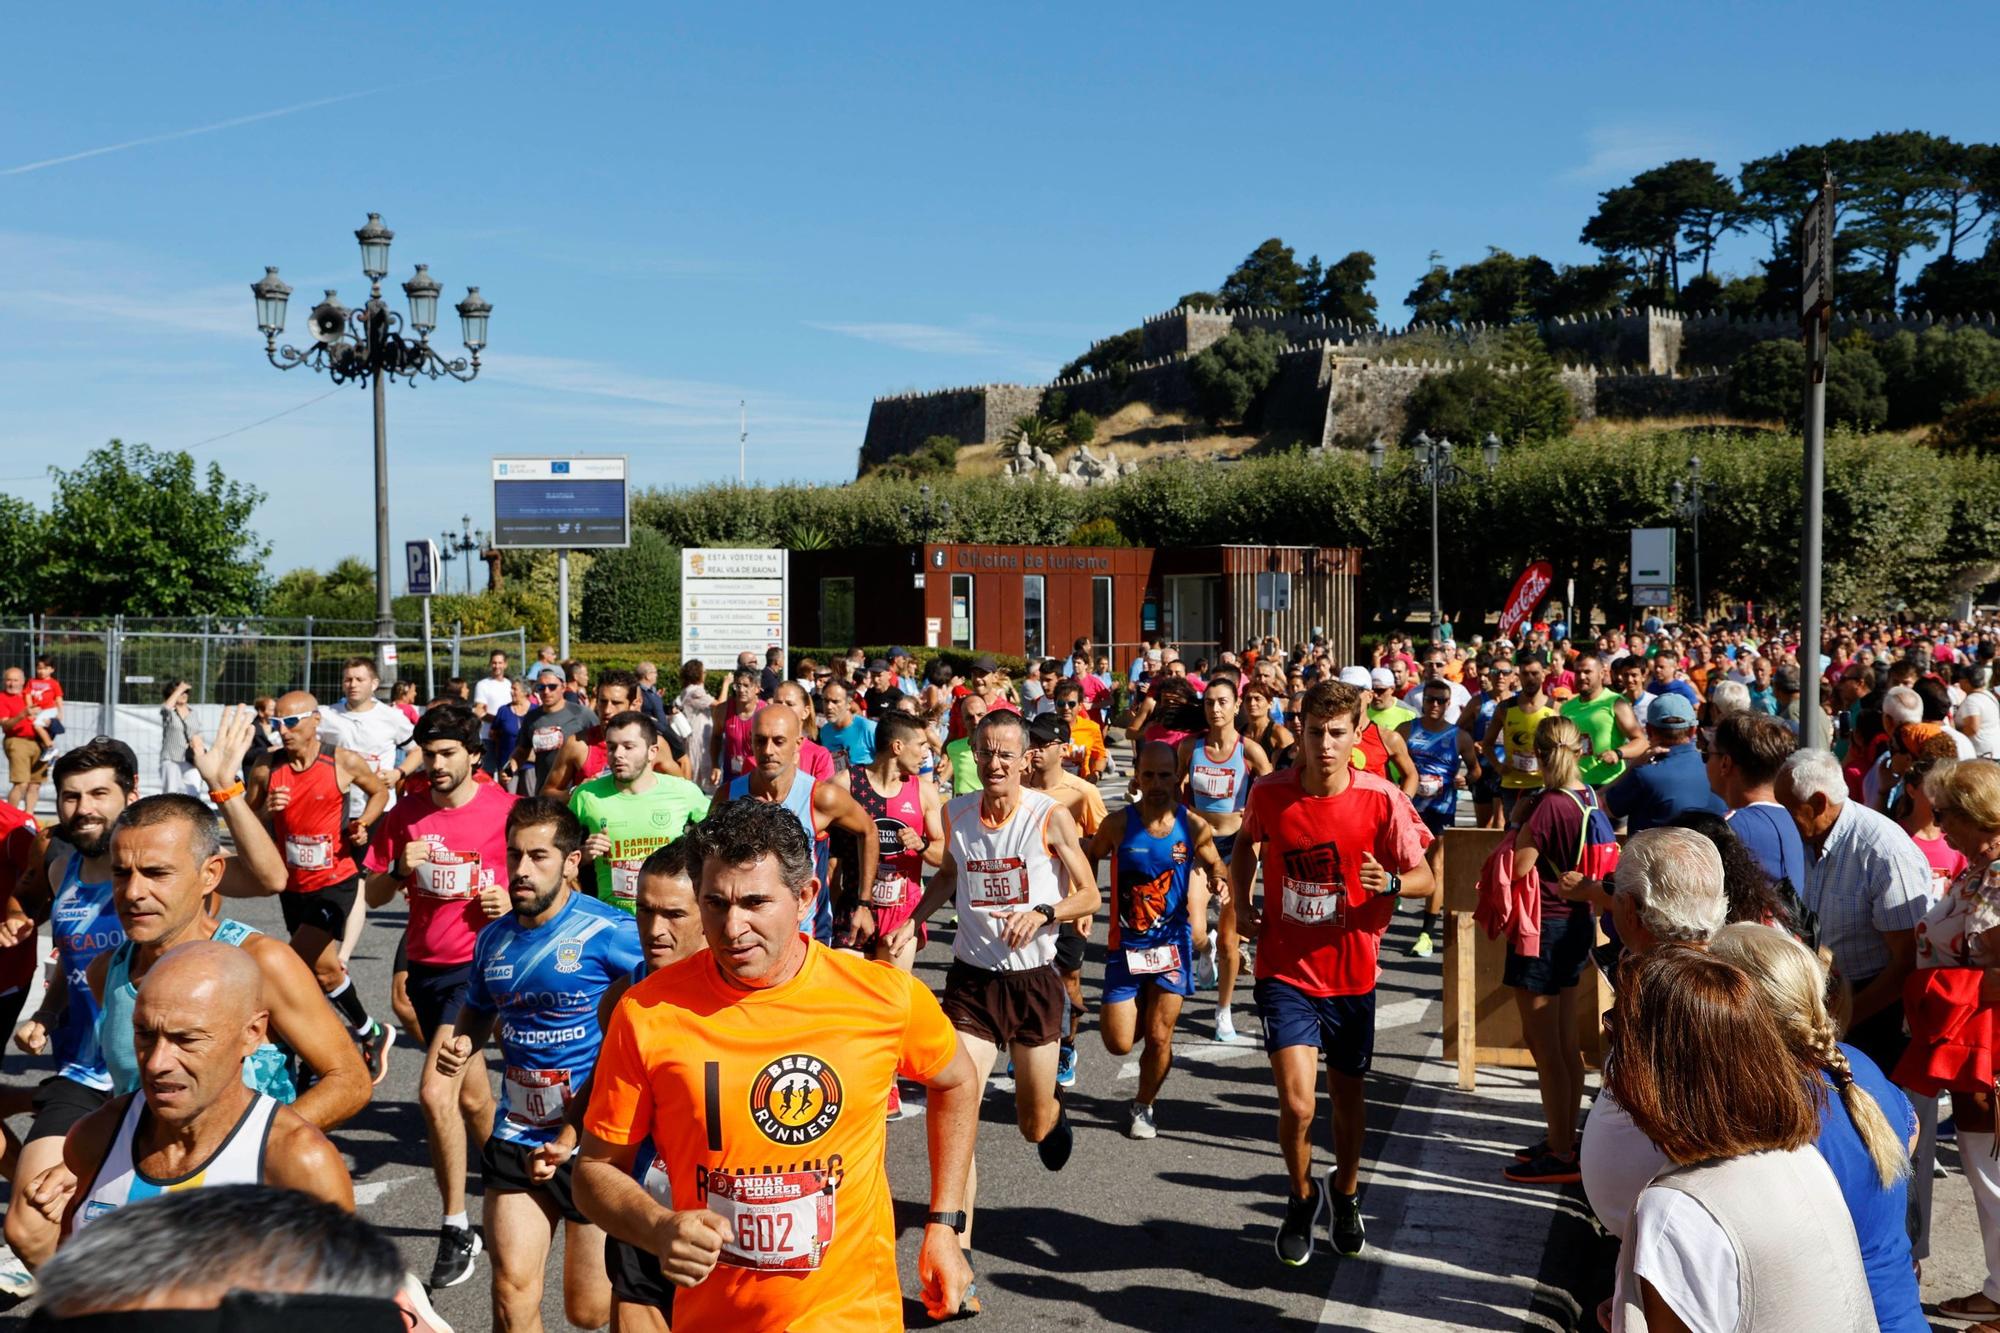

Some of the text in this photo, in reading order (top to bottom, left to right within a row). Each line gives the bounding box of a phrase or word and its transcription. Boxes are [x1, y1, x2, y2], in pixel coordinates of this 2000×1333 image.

[408, 545, 423, 583] P
[730, 553, 764, 561] VOSTEDE
[767, 553, 777, 561] NA
[957, 549, 1018, 568] Oficina
[1024, 552, 1044, 568] de
[1048, 553, 1110, 570] turismo
[707, 566, 777, 574] REAL VILA DE BAIONA
[623, 836, 671, 848] CARREIRA
[299, 848, 314, 863] 86
[432, 869, 456, 890] 613
[983, 877, 1011, 898] 556
[1295, 900, 1325, 918] 444
[518, 1025, 587, 1044] TORVIGO
[767, 1056, 823, 1080] BEER
[526, 1093, 546, 1117] 40
[753, 1102, 839, 1144] RUNNERS
[733, 1176, 784, 1188] ANDAR
[744, 1184, 802, 1197] CORRER
[746, 1205, 782, 1214] MODESTO
[737, 1212, 794, 1253] 602
